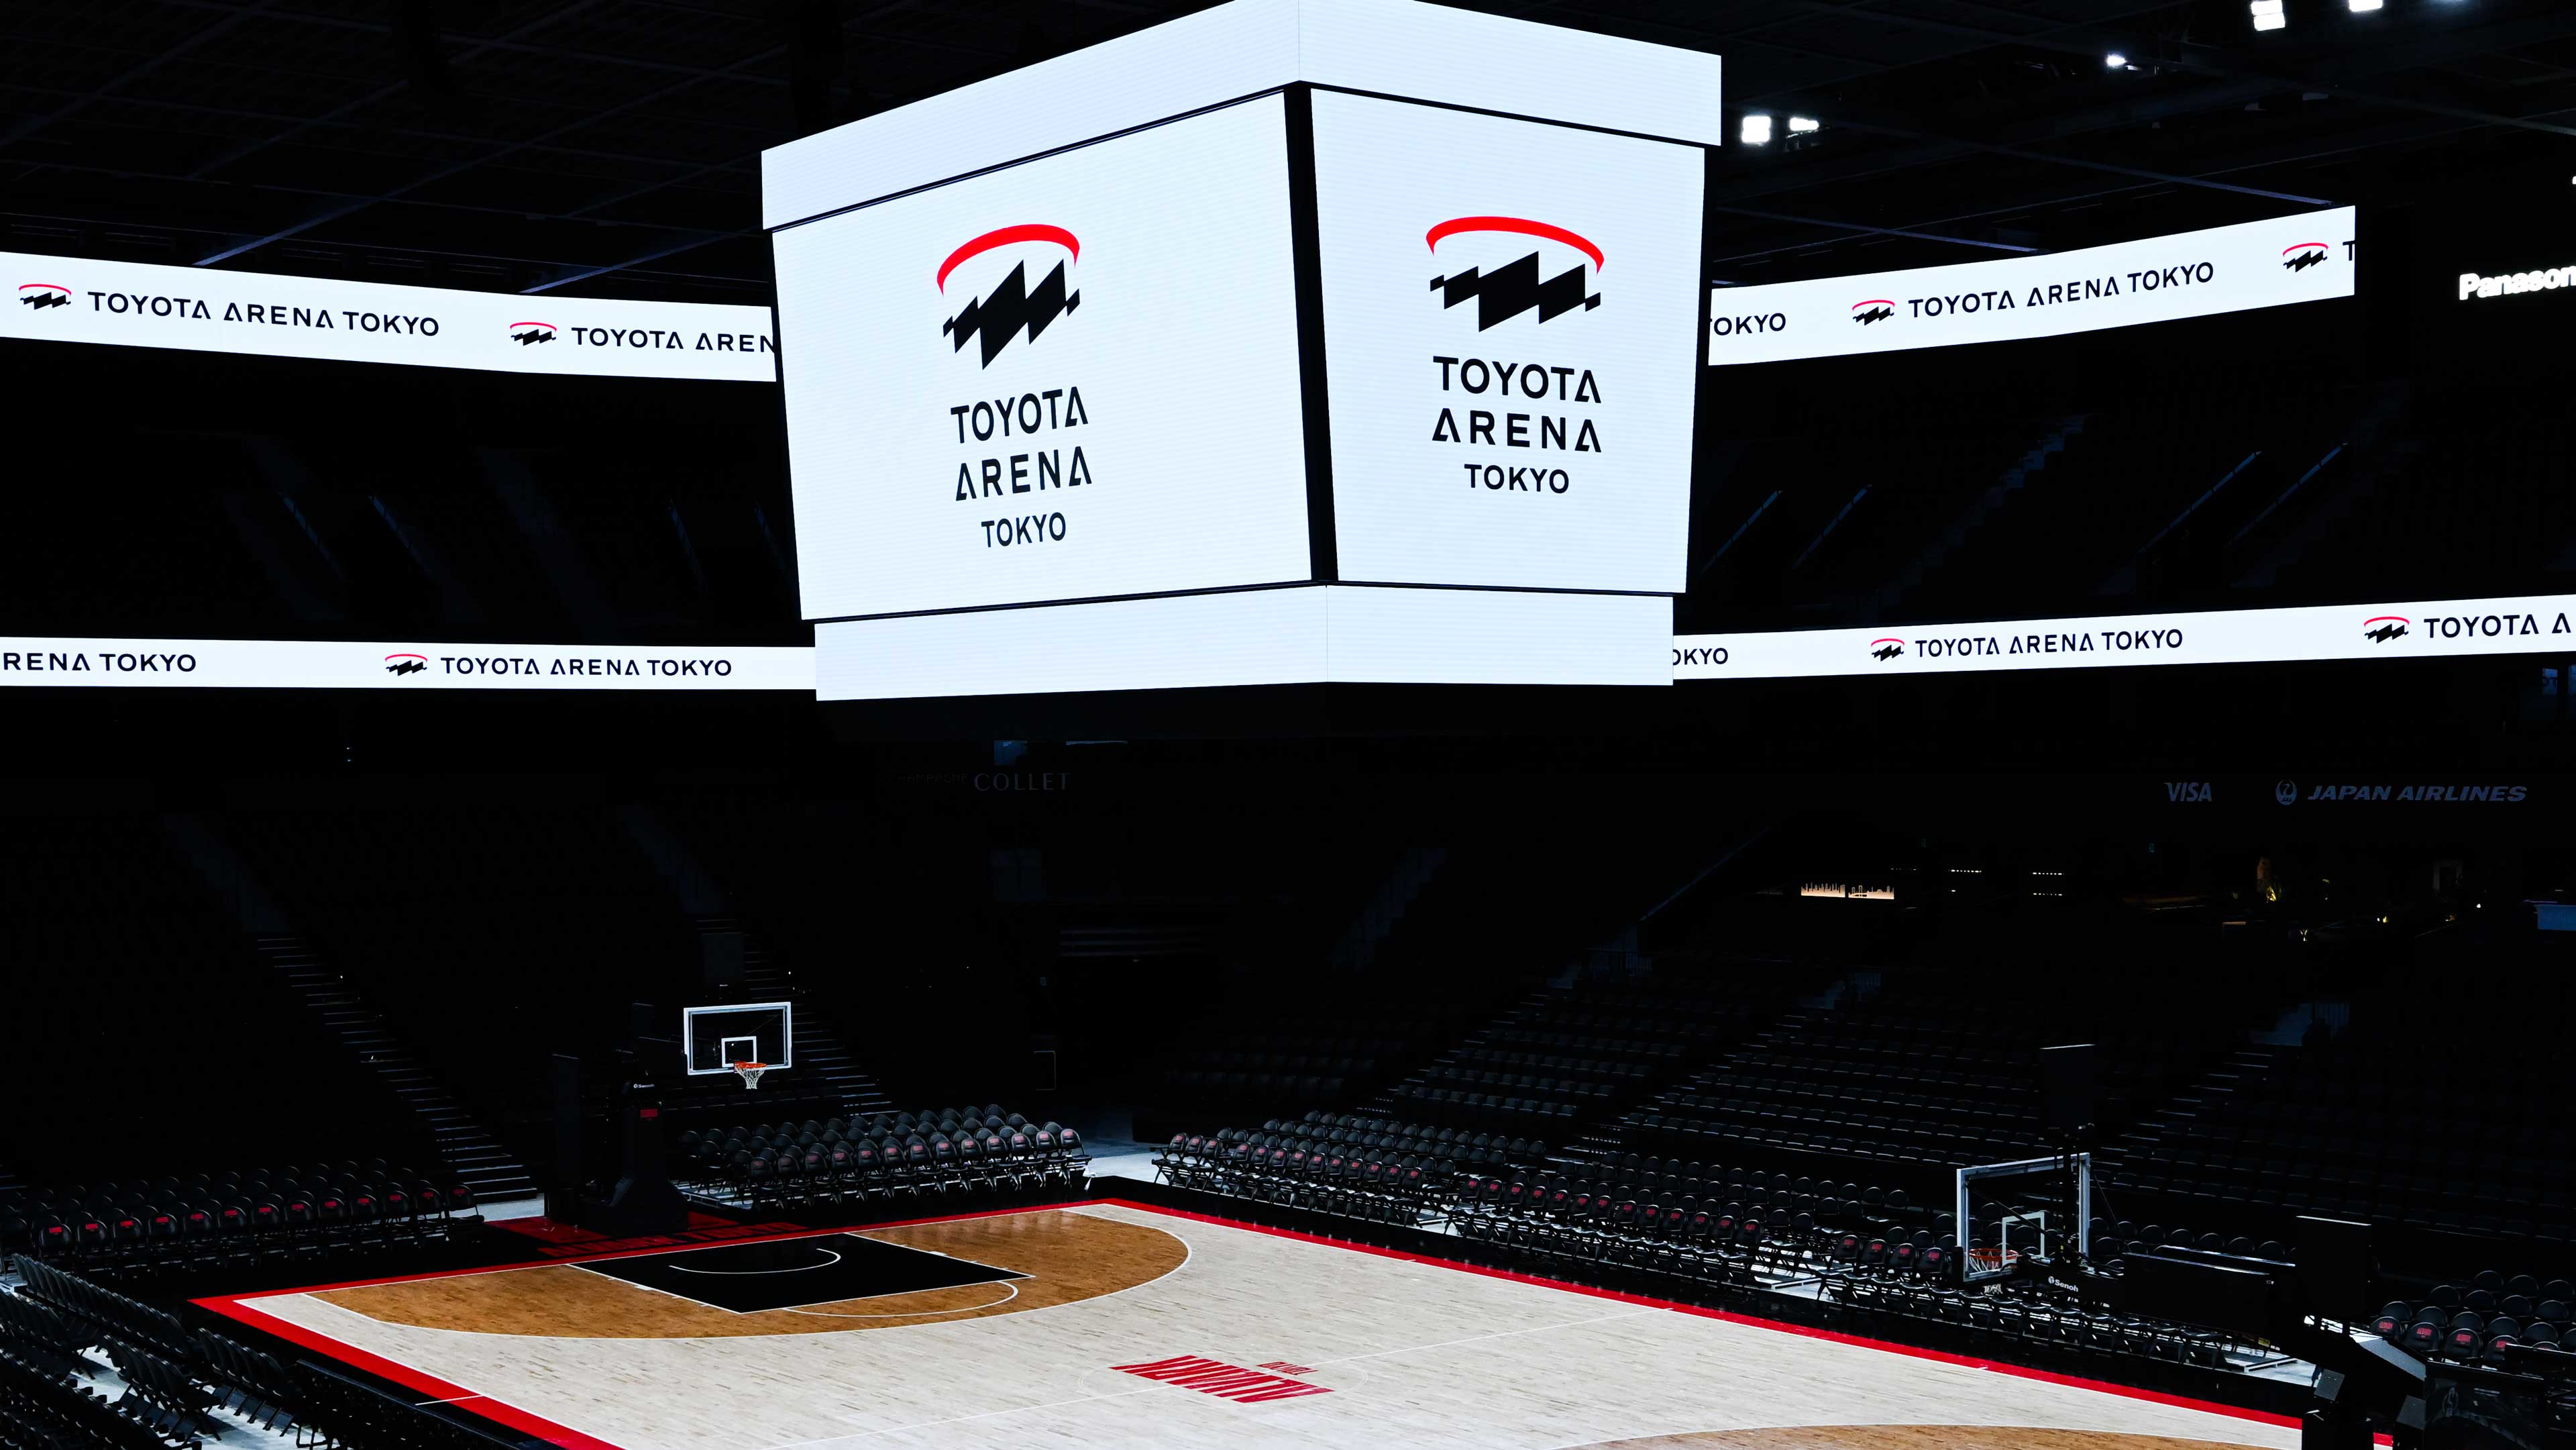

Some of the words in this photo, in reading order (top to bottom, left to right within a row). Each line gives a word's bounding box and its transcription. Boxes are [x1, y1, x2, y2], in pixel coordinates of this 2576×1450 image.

[1909, 291, 2015, 317] TOYOTA
[2027, 277, 2119, 307] ARENA
[2128, 262, 2213, 292] TOKYO
[2459, 266, 2576, 301] Panason
[88, 292, 211, 319] TOYOTA
[224, 303, 333, 328] ARENA
[343, 312, 438, 336] TOKYO
[1710, 313, 1786, 335] OKYO
[572, 327, 683, 349] TOYOTA
[695, 333, 774, 352] AREN
[1434, 356, 1601, 403] TOYOTA
[950, 386, 1089, 444] TOYOTA
[1432, 408, 1601, 452] ARENA
[956, 446, 1091, 501] ARENA
[1464, 464, 1568, 493] TOKYO
[981, 513, 1065, 547] TOKYO
[2424, 615, 2538, 638] TOYOTA
[1915, 637, 1999, 657] TOYOTA
[2010, 633, 2094, 654] ARENA
[2102, 629, 2182, 650] TOKYO
[4, 653, 90, 670] RENA
[99, 654, 195, 672] TOKYO
[441, 658, 539, 674] TOYOTA
[551, 660, 639, 675] ARENA
[647, 660, 731, 676] TOKYO
[973, 773, 1071, 791] COLLET
[2164, 782, 2212, 802] VISA
[2308, 785, 2392, 801] JAPAN
[2396, 785, 2528, 802] AIRLINES
[2055, 1279, 2079, 1292] Senoh
